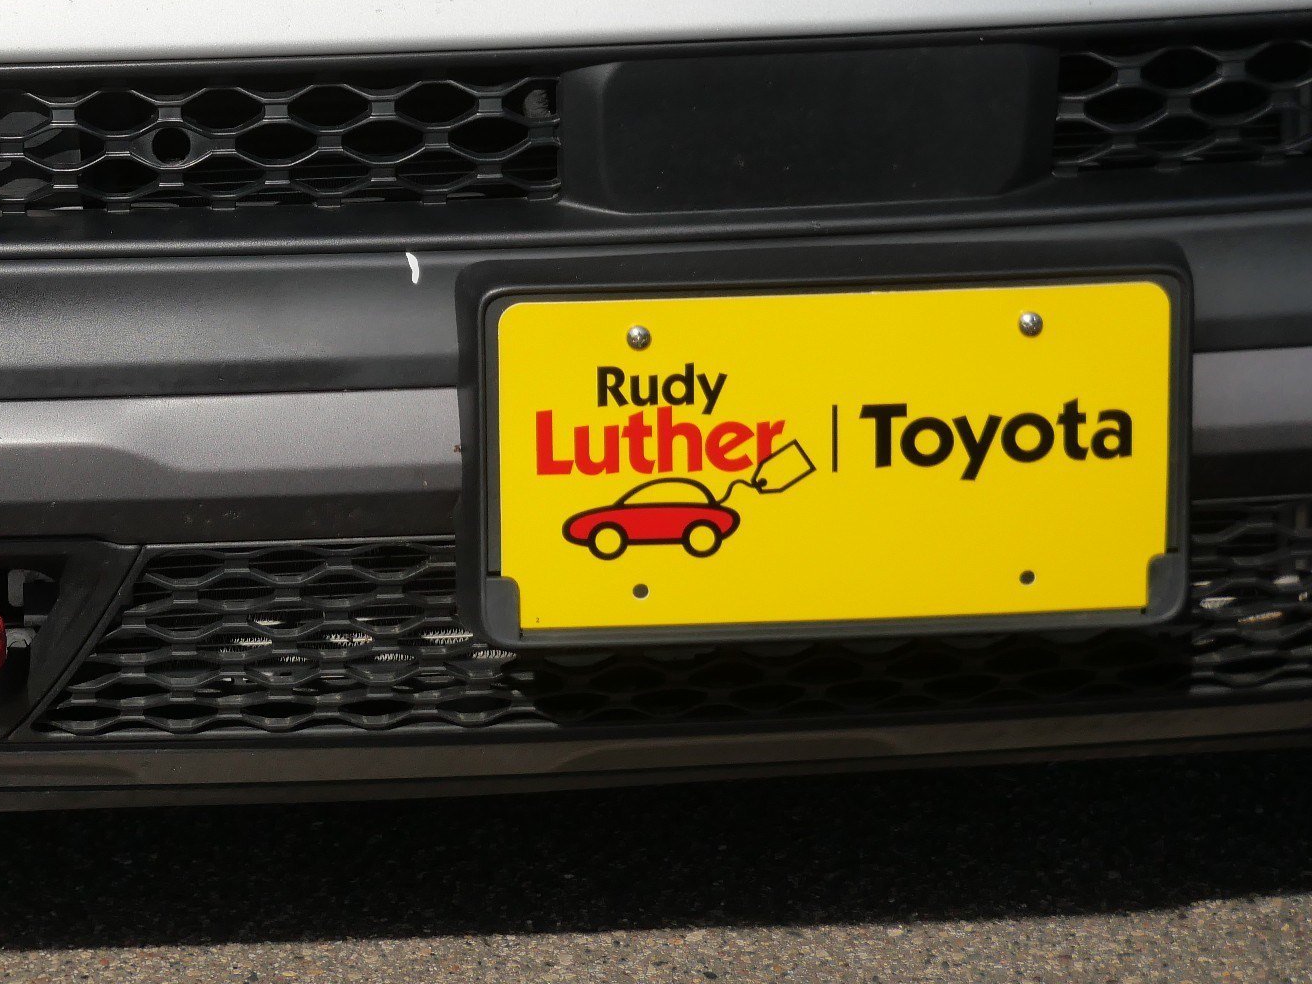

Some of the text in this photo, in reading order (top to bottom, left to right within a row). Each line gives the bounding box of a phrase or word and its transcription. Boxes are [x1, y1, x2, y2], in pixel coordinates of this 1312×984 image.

[596, 362, 728, 414] Rudy
[535, 404, 786, 477] Luther
[859, 397, 1134, 481] Toyota
